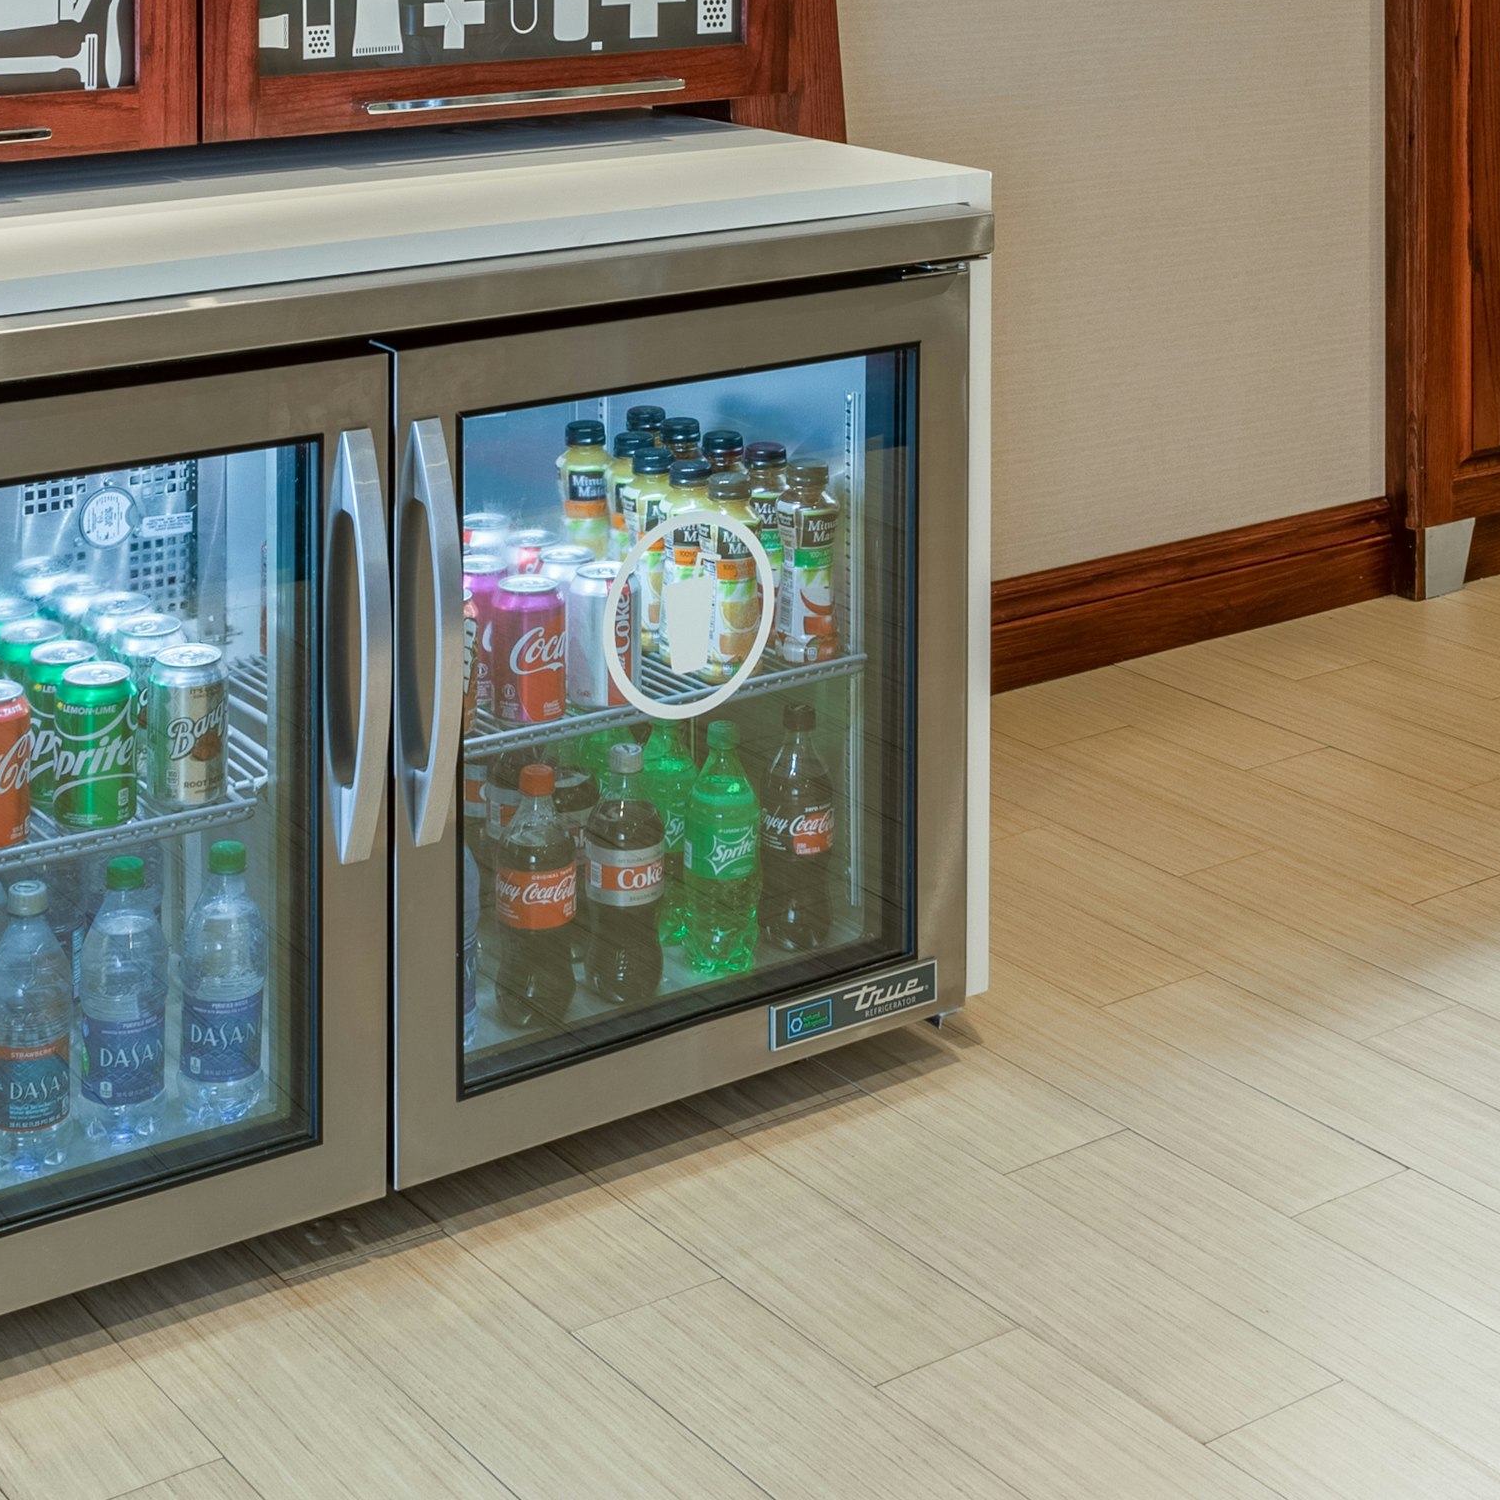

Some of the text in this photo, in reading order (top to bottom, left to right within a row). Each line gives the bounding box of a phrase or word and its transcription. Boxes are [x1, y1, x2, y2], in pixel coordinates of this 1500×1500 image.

[615, 593, 630, 654] Coke
[3, 703, 23, 717] TASTE
[62, 704, 117, 716] LEMON-LIME
[183, 780, 207, 789] ROOT
[617, 865, 663, 890] Coke
[843, 977, 925, 1012] true
[864, 995, 917, 1018] REFRIGERATOR
